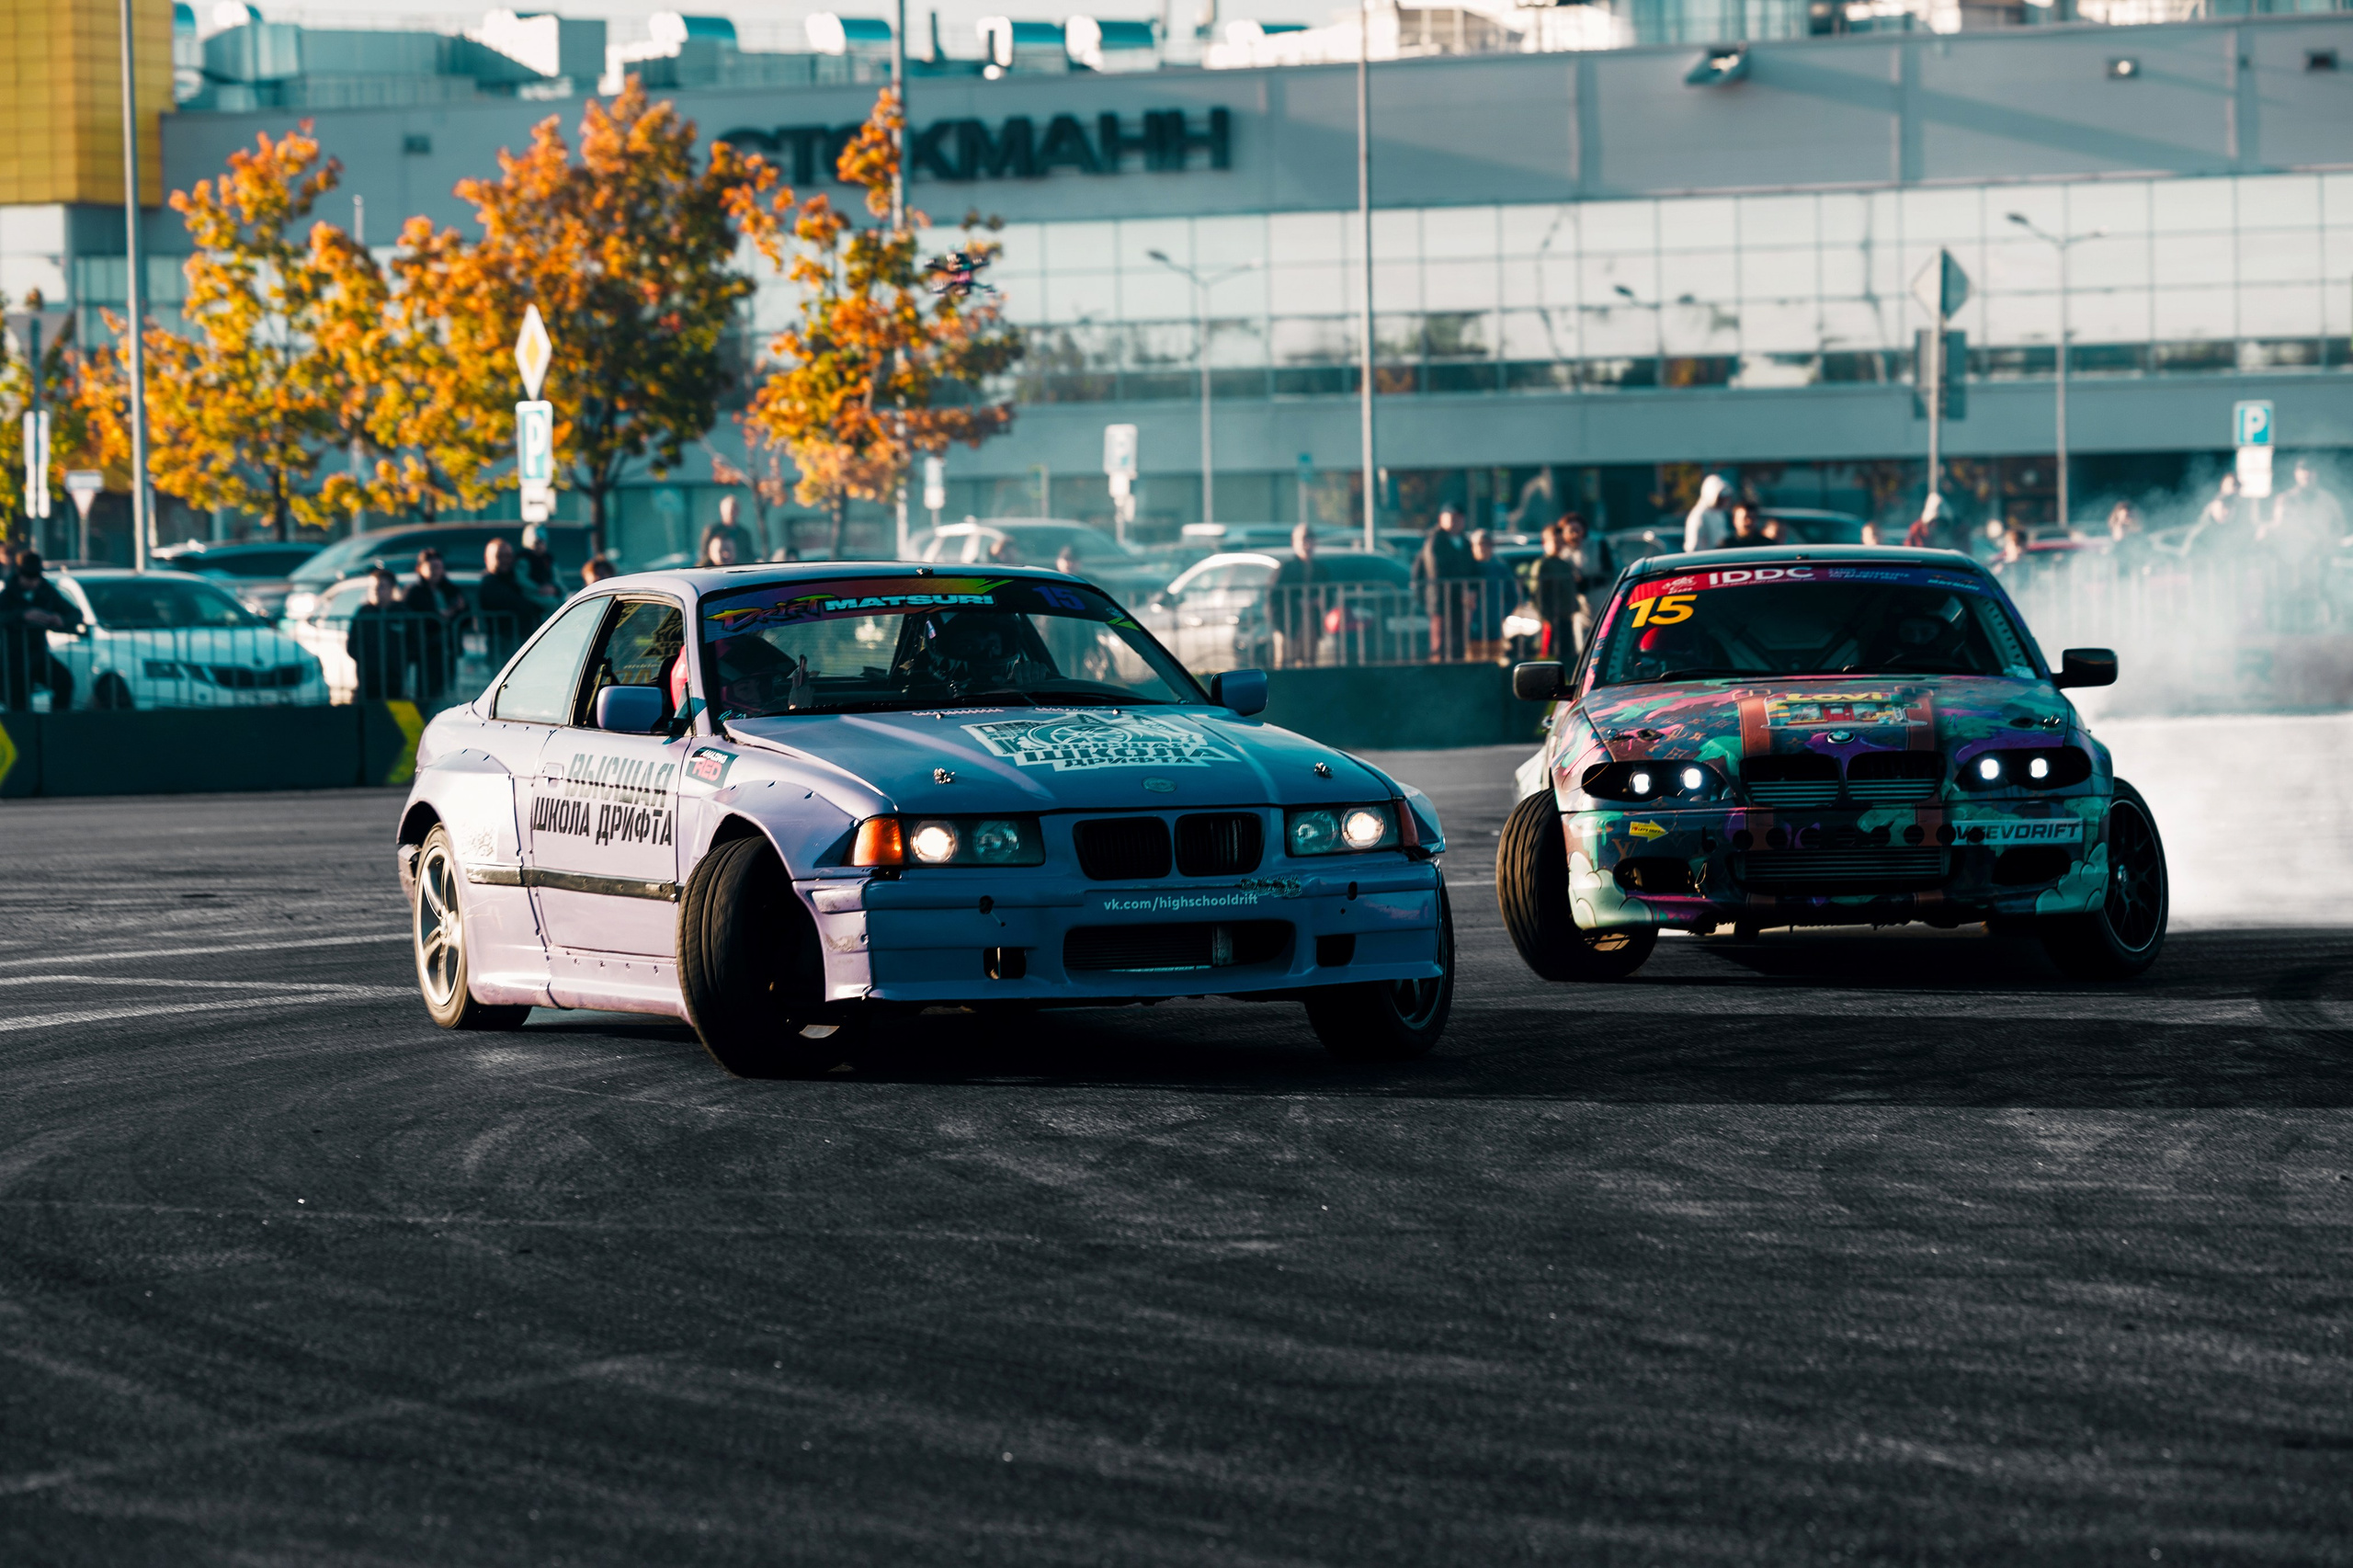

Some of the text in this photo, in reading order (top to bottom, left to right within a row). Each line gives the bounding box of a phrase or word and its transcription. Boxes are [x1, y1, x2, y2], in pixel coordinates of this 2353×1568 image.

[2245, 405, 2268, 442] P
[525, 412, 546, 476] P
[1709, 566, 1814, 585] IDDC
[824, 594, 995, 610] MATSURI
[1031, 585, 1086, 610] 15
[1628, 595, 1698, 628] 15
[1023, 747, 1227, 762] ШКОЛА
[1064, 756, 1196, 767] ДРИФТА
[564, 753, 676, 808] ВЫСШАЯ
[691, 759, 722, 781] RED
[533, 796, 672, 846] ШКОЛА ДРИФТА
[1104, 893, 1258, 912] vk.com/highschooldrift
